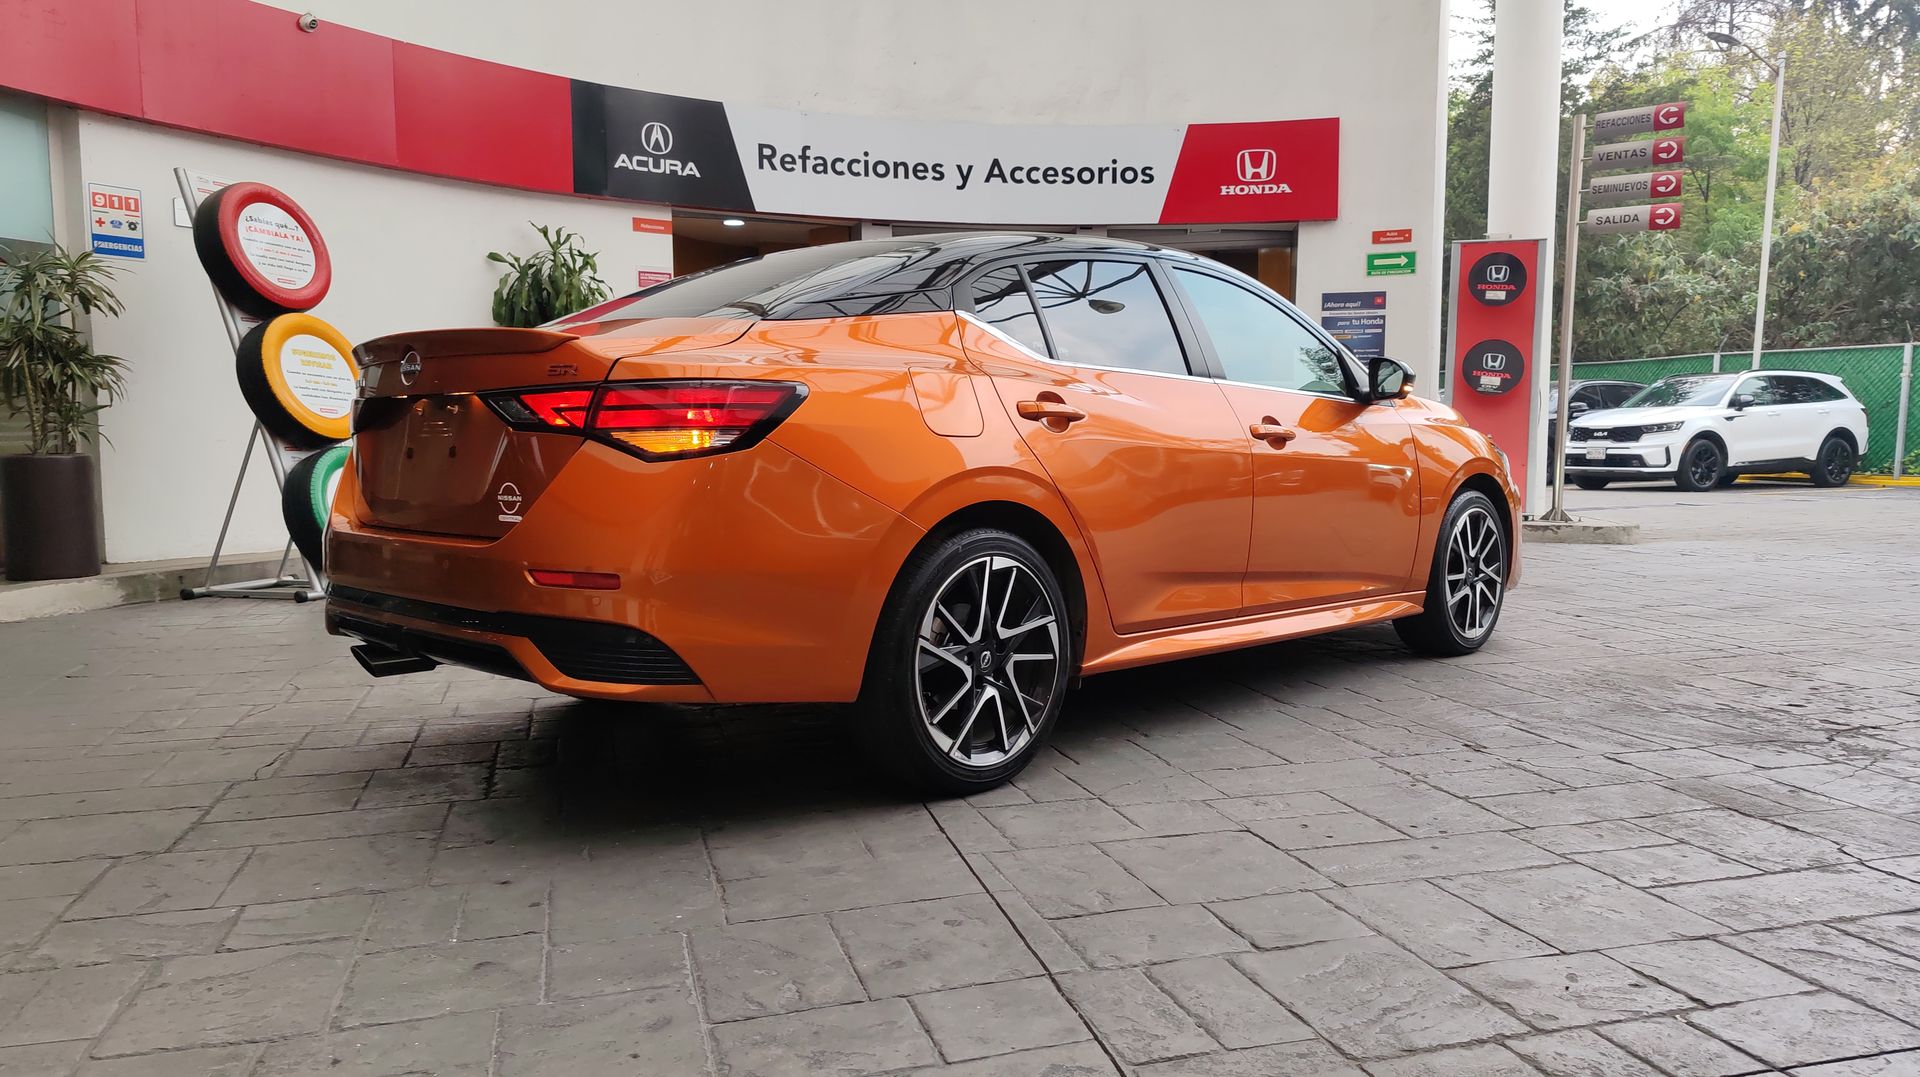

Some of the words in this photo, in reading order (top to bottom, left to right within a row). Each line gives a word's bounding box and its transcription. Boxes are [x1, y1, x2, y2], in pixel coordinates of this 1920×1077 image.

[1595, 113, 1652, 129] REFACCIONES
[1598, 148, 1647, 161] VENTAS
[614, 153, 701, 178] ACURA
[757, 143, 945, 181] Refacciones
[956, 164, 974, 190] y
[984, 158, 1155, 184] Accesorios
[1220, 183, 1293, 195] HONDA
[1591, 181, 1648, 195] SEMINUEVOS
[94, 194, 136, 211] 911
[1595, 214, 1640, 226] SALIDA
[93, 240, 143, 253] EMERGENCIAS
[548, 363, 577, 376] SR
[1472, 370, 1511, 379] HONDA
